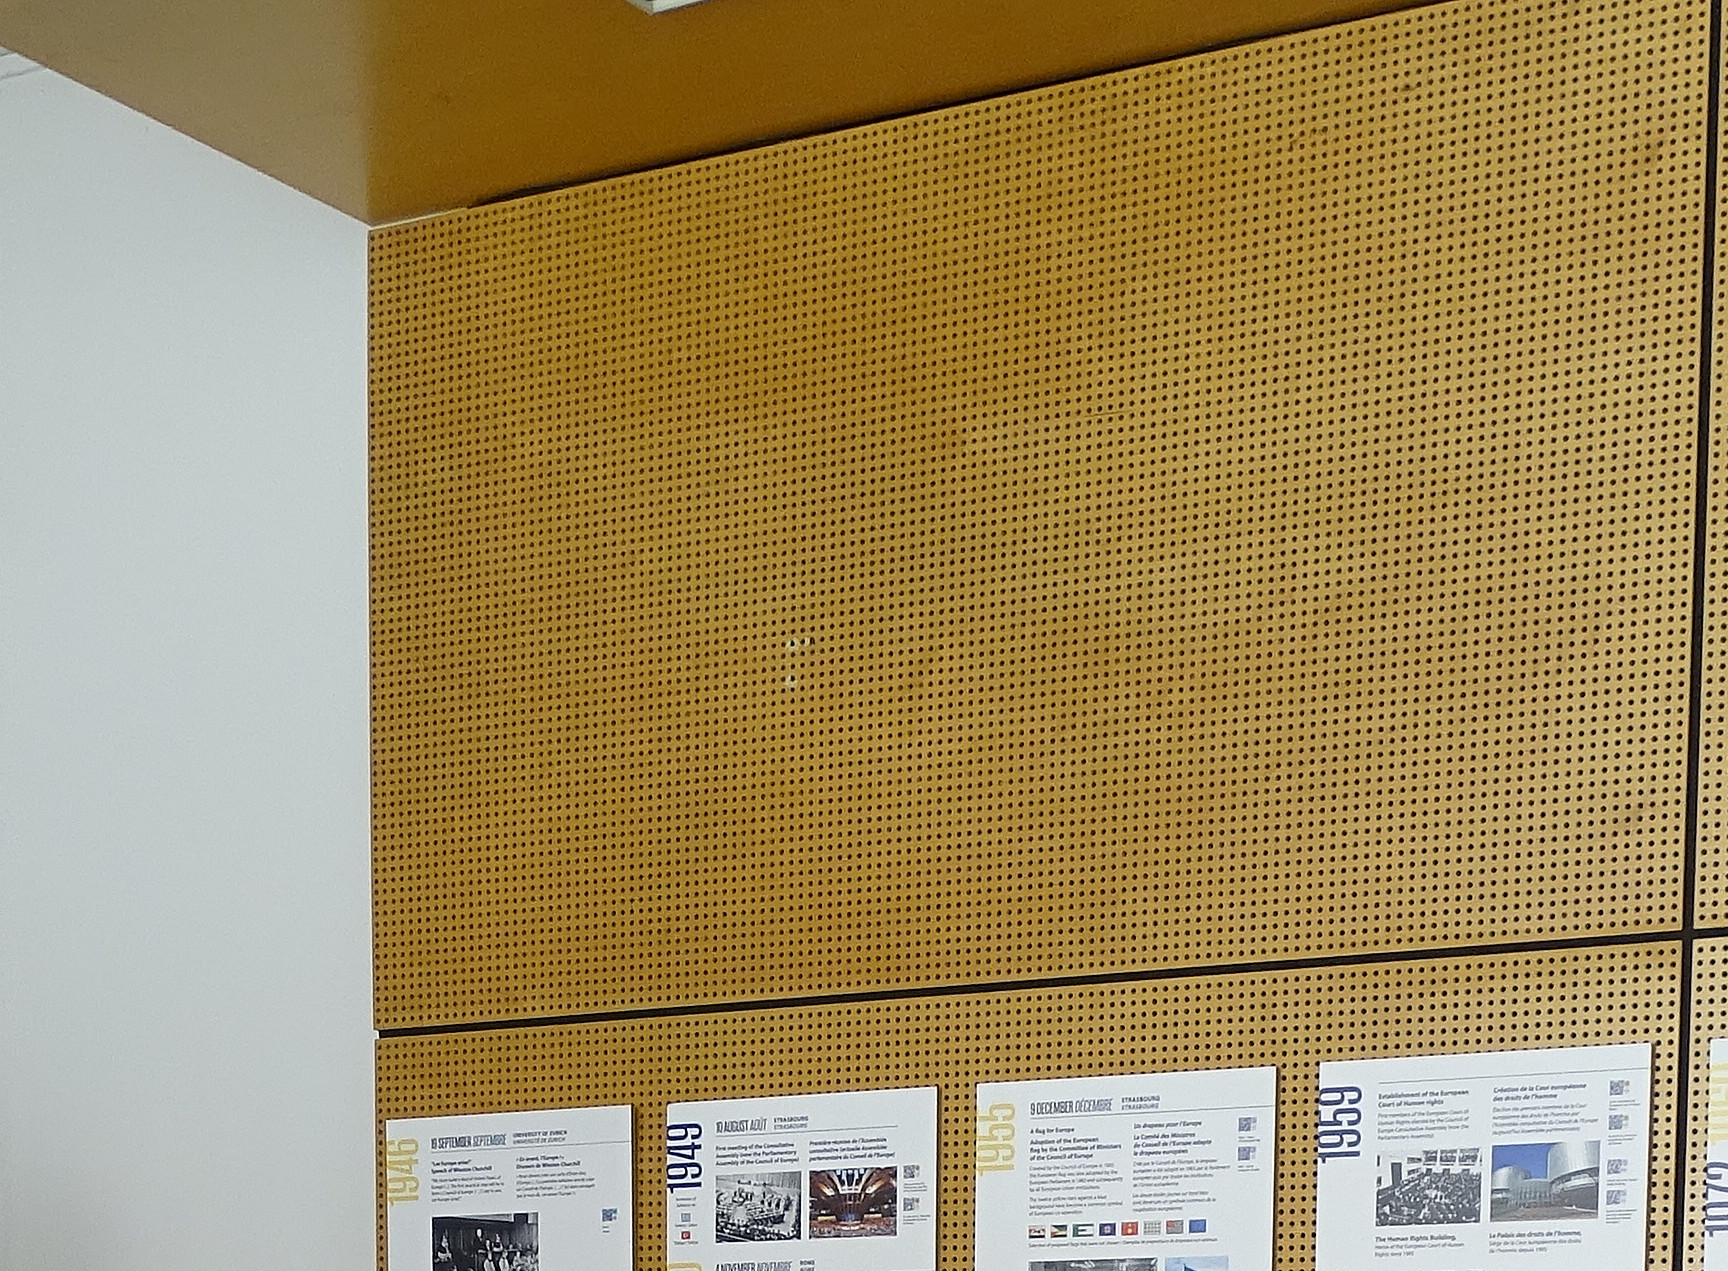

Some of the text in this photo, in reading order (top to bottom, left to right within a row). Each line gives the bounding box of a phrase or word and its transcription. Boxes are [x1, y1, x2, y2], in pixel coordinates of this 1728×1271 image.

[1036, 1101, 1073, 1115] DECEMBER
[1074, 1097, 1114, 1113] DÉCEMBRE
[723, 1119, 749, 1132] AUGUST
[1318, 1086, 1362, 1164] 1959
[438, 1134, 472, 1149] SEPTEMBER
[666, 1123, 702, 1194] 1949
